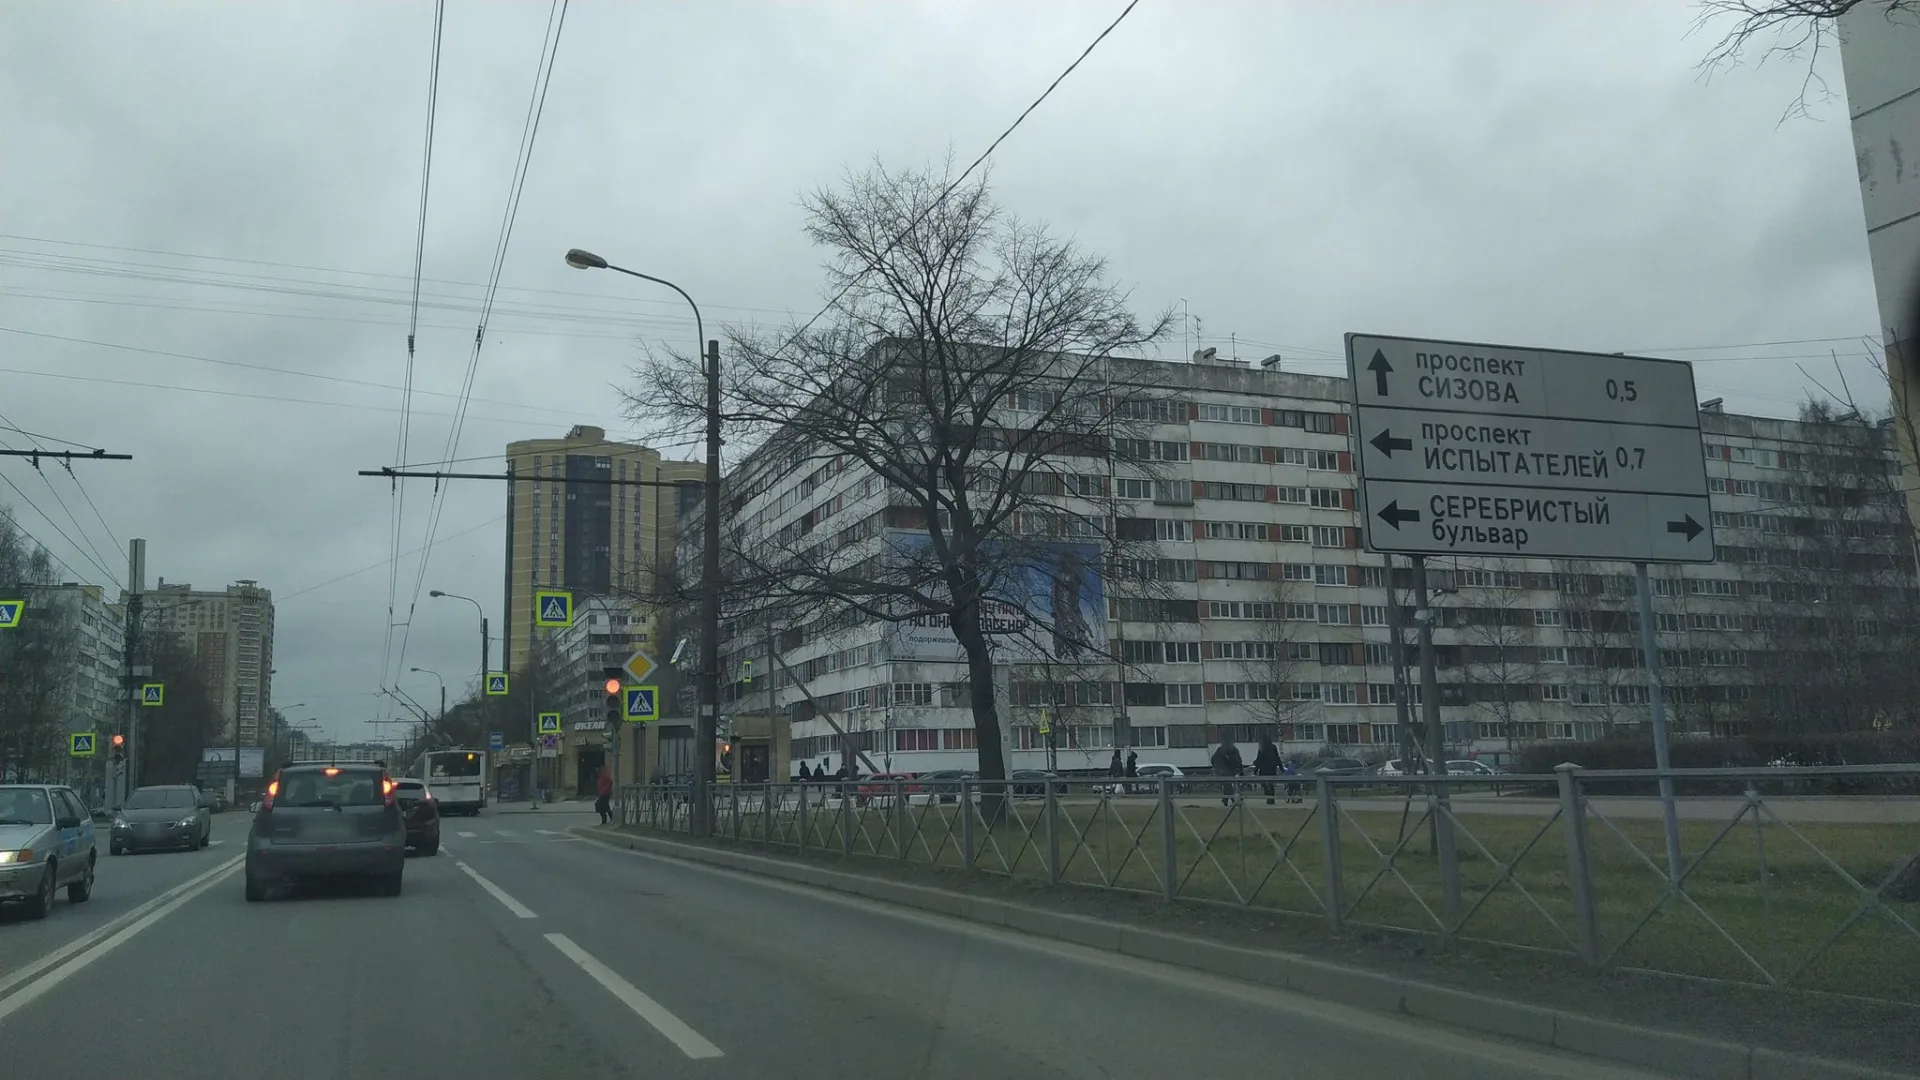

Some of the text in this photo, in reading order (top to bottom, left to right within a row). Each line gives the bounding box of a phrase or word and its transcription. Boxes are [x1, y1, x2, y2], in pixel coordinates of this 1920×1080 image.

[1416, 351, 1525, 377] проспект
[1418, 375, 1520, 404] СИЗОВА
[1605, 378, 1638, 403] 0,5
[1421, 422, 1532, 446] проспект
[1424, 446, 1609, 479] ИСПЫТАТЕЛЕЙ
[1615, 445, 1646, 472] 0,7
[1430, 494, 1611, 525] СЕРЕБРИСТЫЙ
[1432, 519, 1529, 550] бульвар
